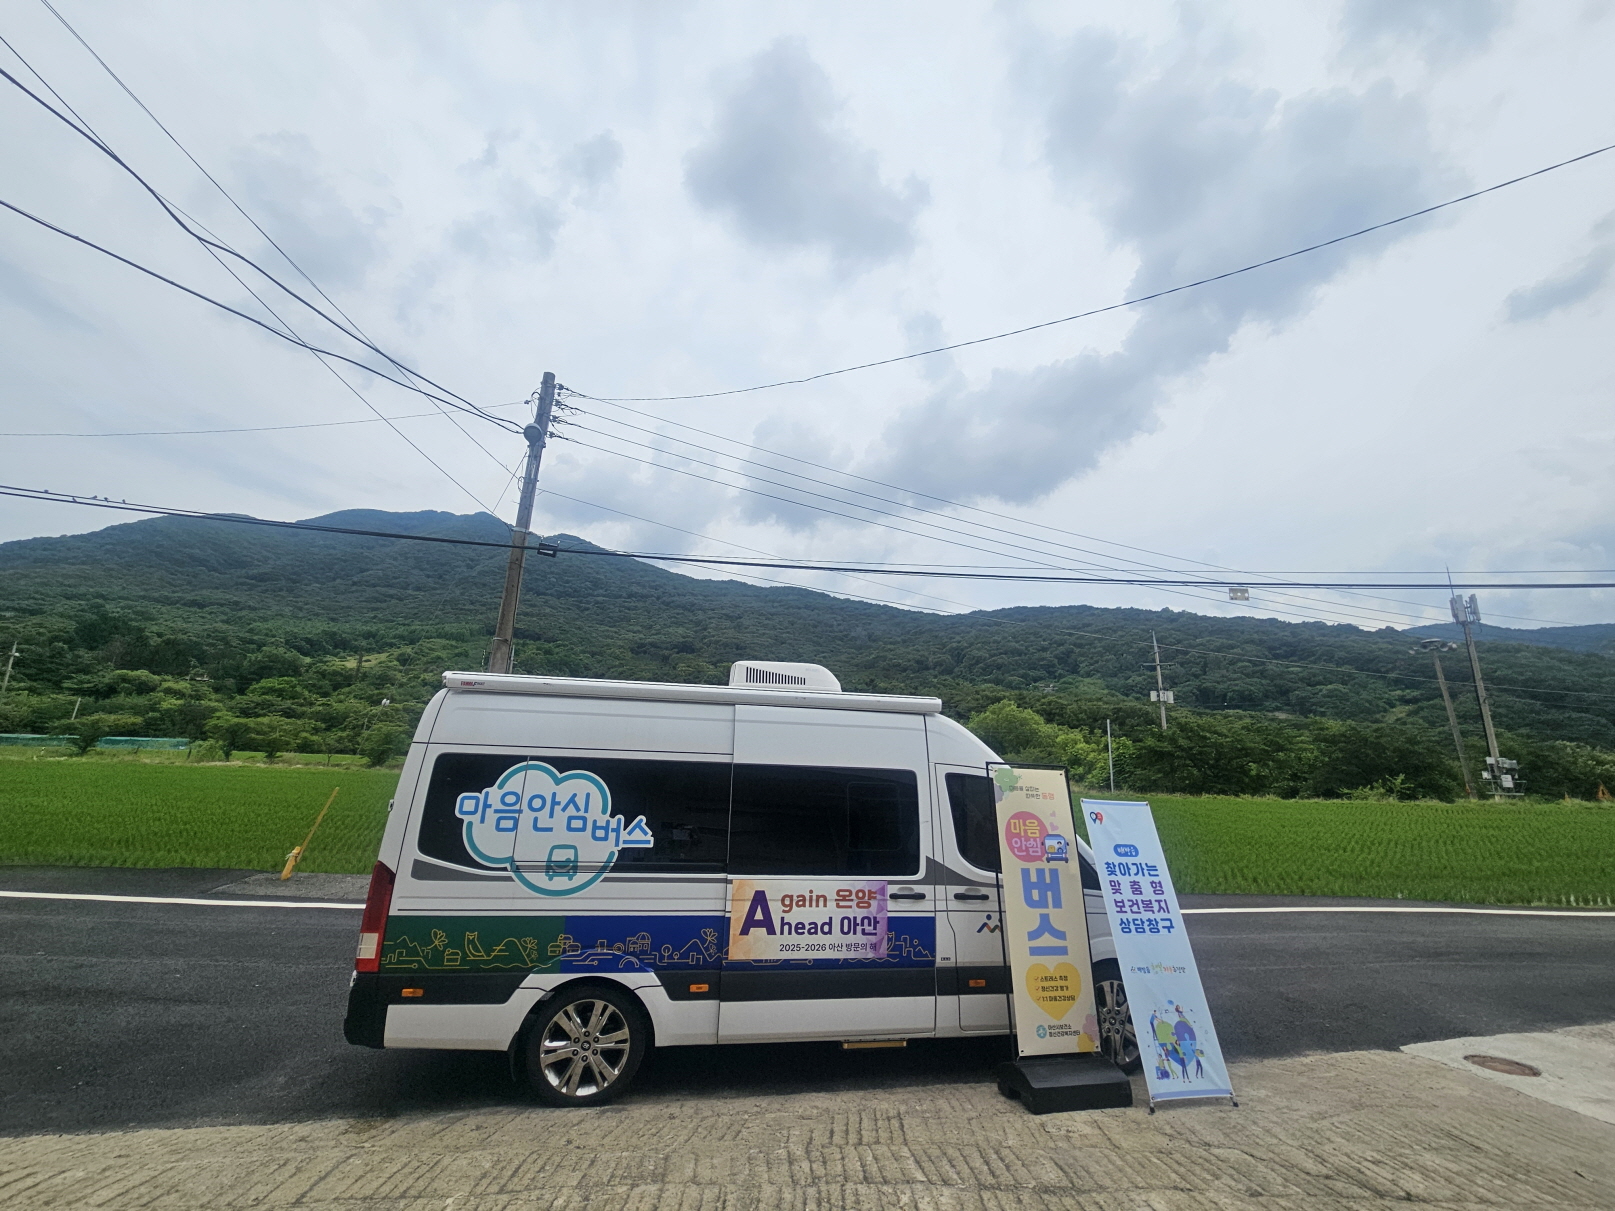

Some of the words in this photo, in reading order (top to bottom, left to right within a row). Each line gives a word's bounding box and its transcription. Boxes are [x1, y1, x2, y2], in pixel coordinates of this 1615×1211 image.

[458, 790, 652, 847] 마음안심버스
[1010, 819, 1040, 837] 마음
[1104, 861, 1160, 877] 찾아가는
[739, 890, 777, 936] A
[781, 890, 828, 913] gain
[834, 888, 877, 909] 온양
[1021, 868, 1068, 956] 버스
[1113, 899, 1171, 914] 보건복지
[779, 916, 833, 936] head
[839, 915, 880, 936] 아산
[1119, 918, 1175, 934] 상담창구
[779, 943, 827, 952] 2025-2026
[828, 943, 844, 952] 아산
[845, 943, 868, 952] 방문의
[869, 943, 877, 952] 해
[1048, 1030, 1081, 1038] 정신건강복지센터
